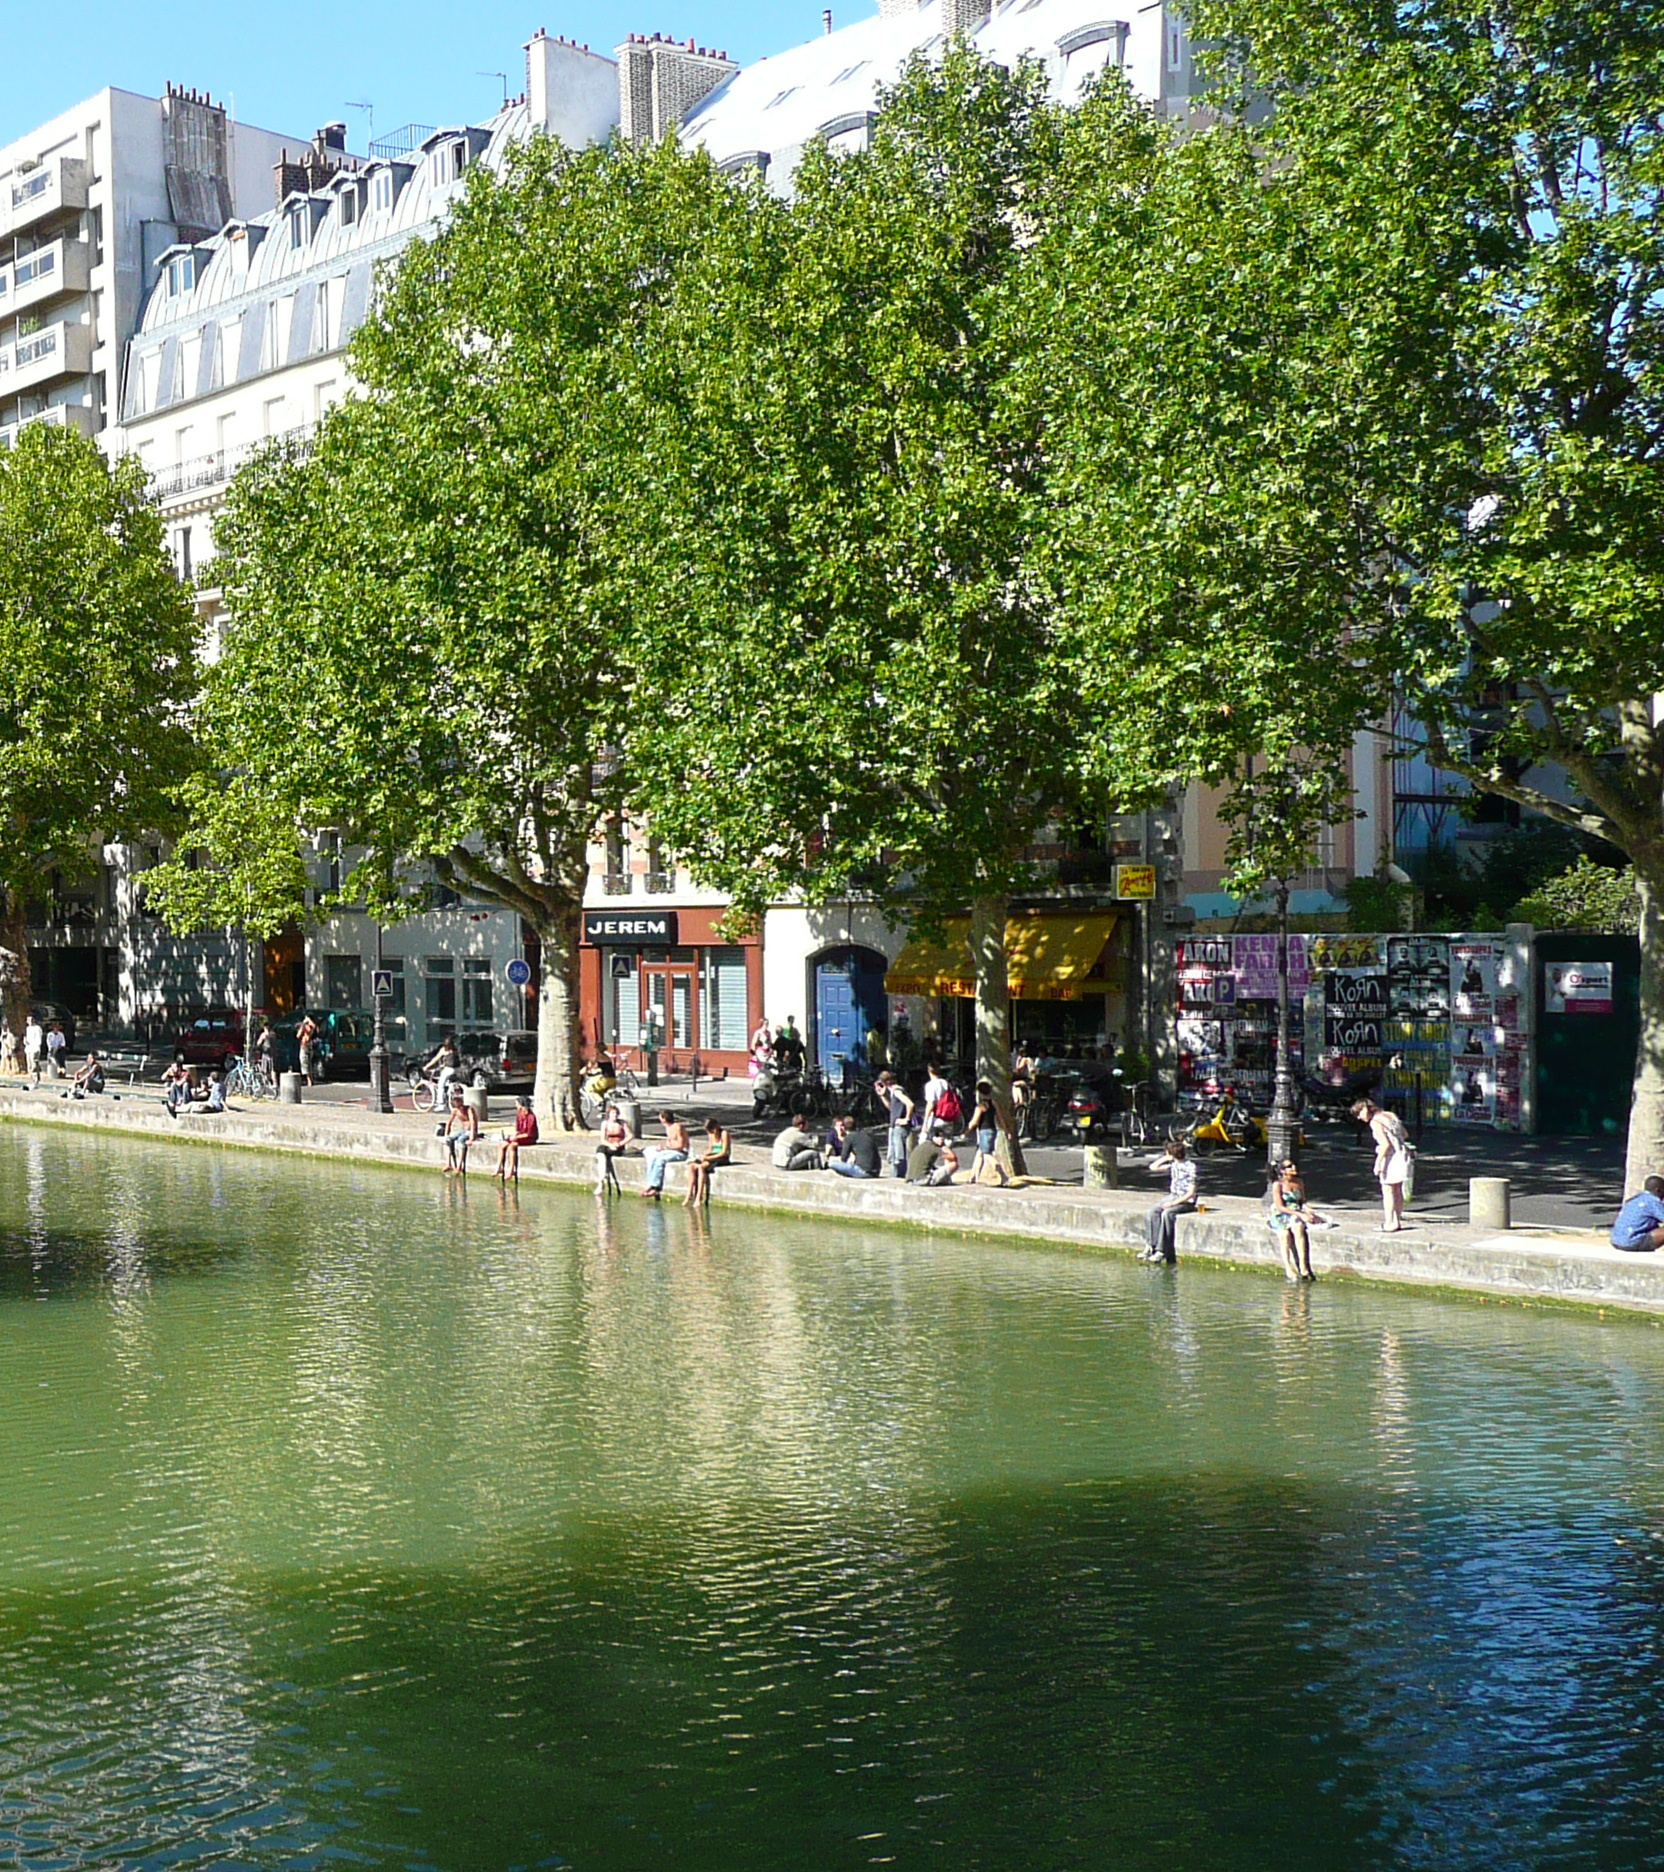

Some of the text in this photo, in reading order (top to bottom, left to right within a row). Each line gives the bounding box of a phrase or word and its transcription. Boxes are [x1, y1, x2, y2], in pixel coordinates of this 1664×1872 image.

[587, 920, 666, 935] JEREM
[1236, 936, 1304, 952] KENA
[1182, 943, 1230, 962] AKON
[1236, 954, 1305, 970] FARH
[940, 982, 1026, 998] RESTNT
[1182, 983, 1214, 1002] AKO
[1219, 983, 1230, 1001] P
